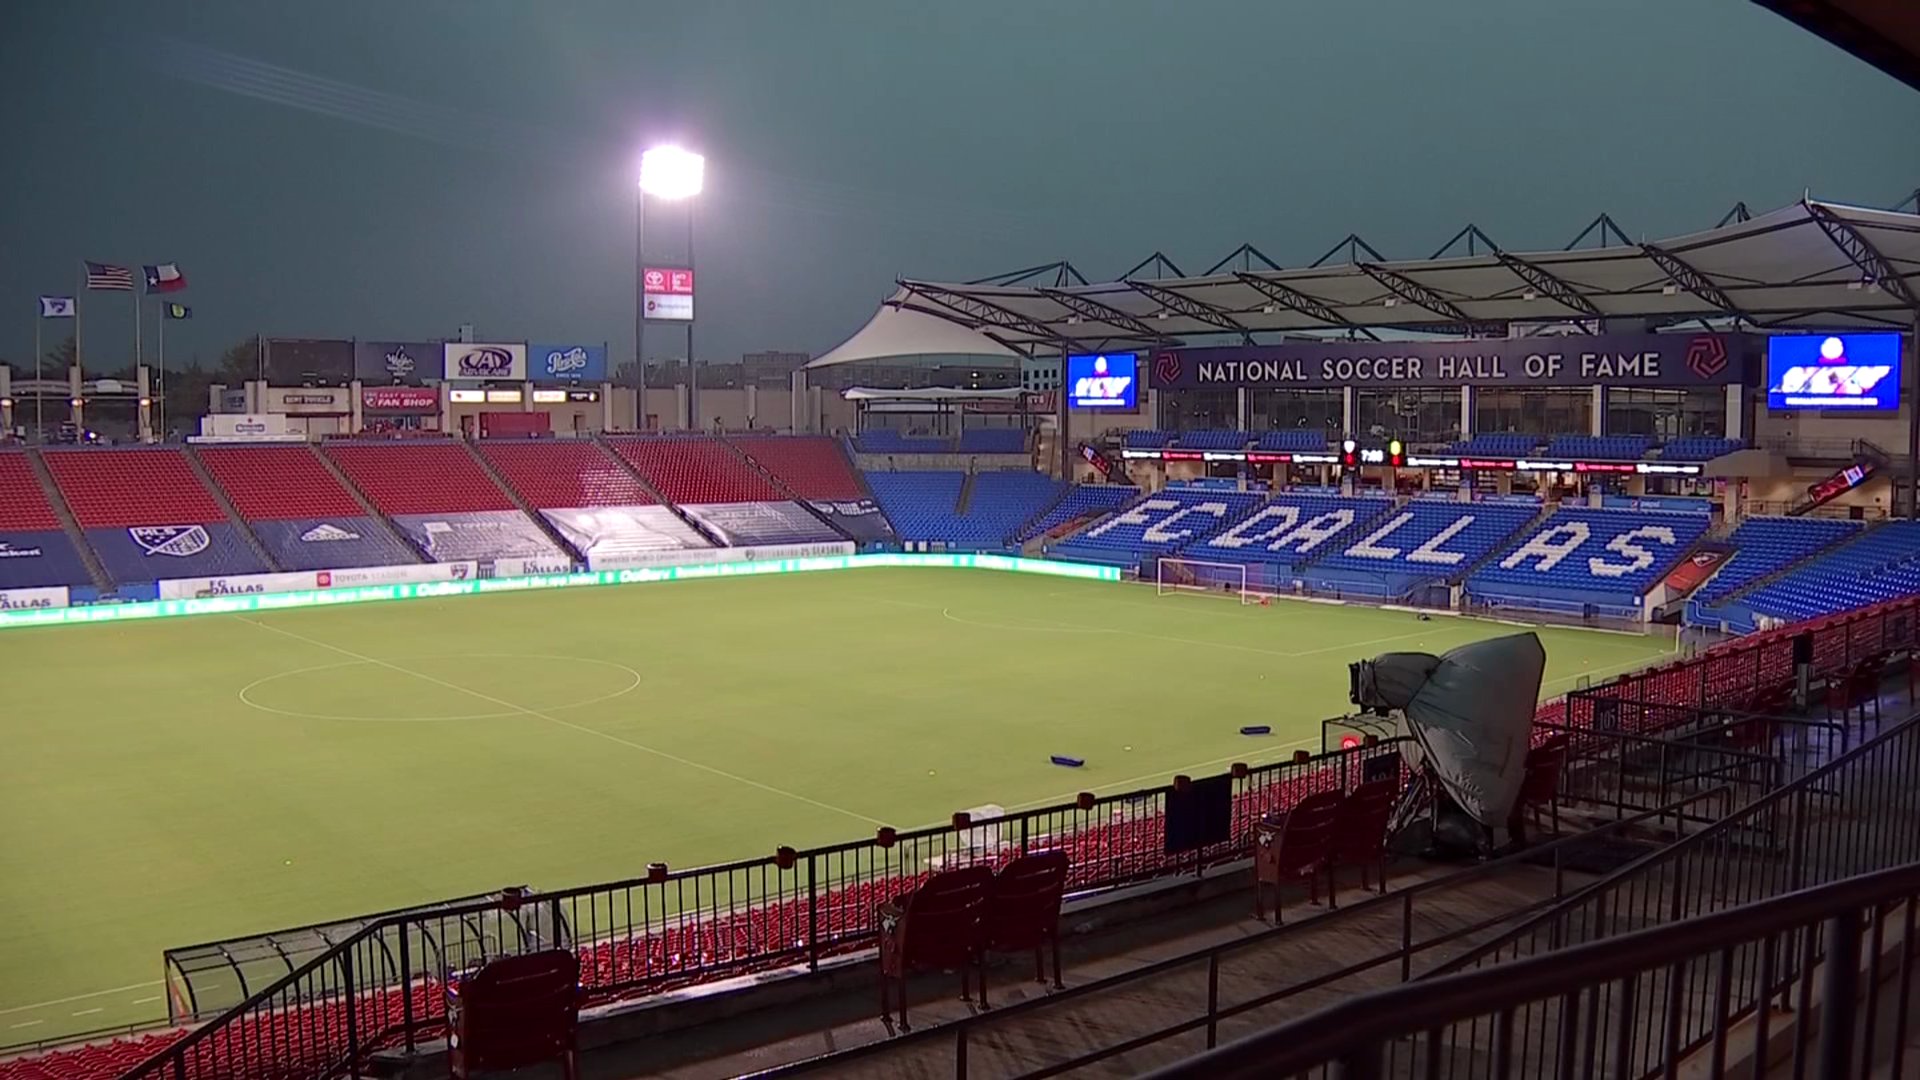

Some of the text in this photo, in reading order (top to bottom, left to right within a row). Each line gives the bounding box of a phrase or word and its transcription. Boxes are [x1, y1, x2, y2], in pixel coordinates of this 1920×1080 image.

[1199, 353, 1660, 382] NATIONAL SOCCER HALL OF FAME
[377, 398, 434, 407] FAN SHOP
[138, 527, 178, 537] MLS
[301, 531, 361, 542] adidas
[1087, 500, 1677, 577] FC DALLAS
[523, 563, 569, 575] DALLAS
[334, 574, 368, 583] TOYOTA
[210, 583, 264, 595] DALLAS
